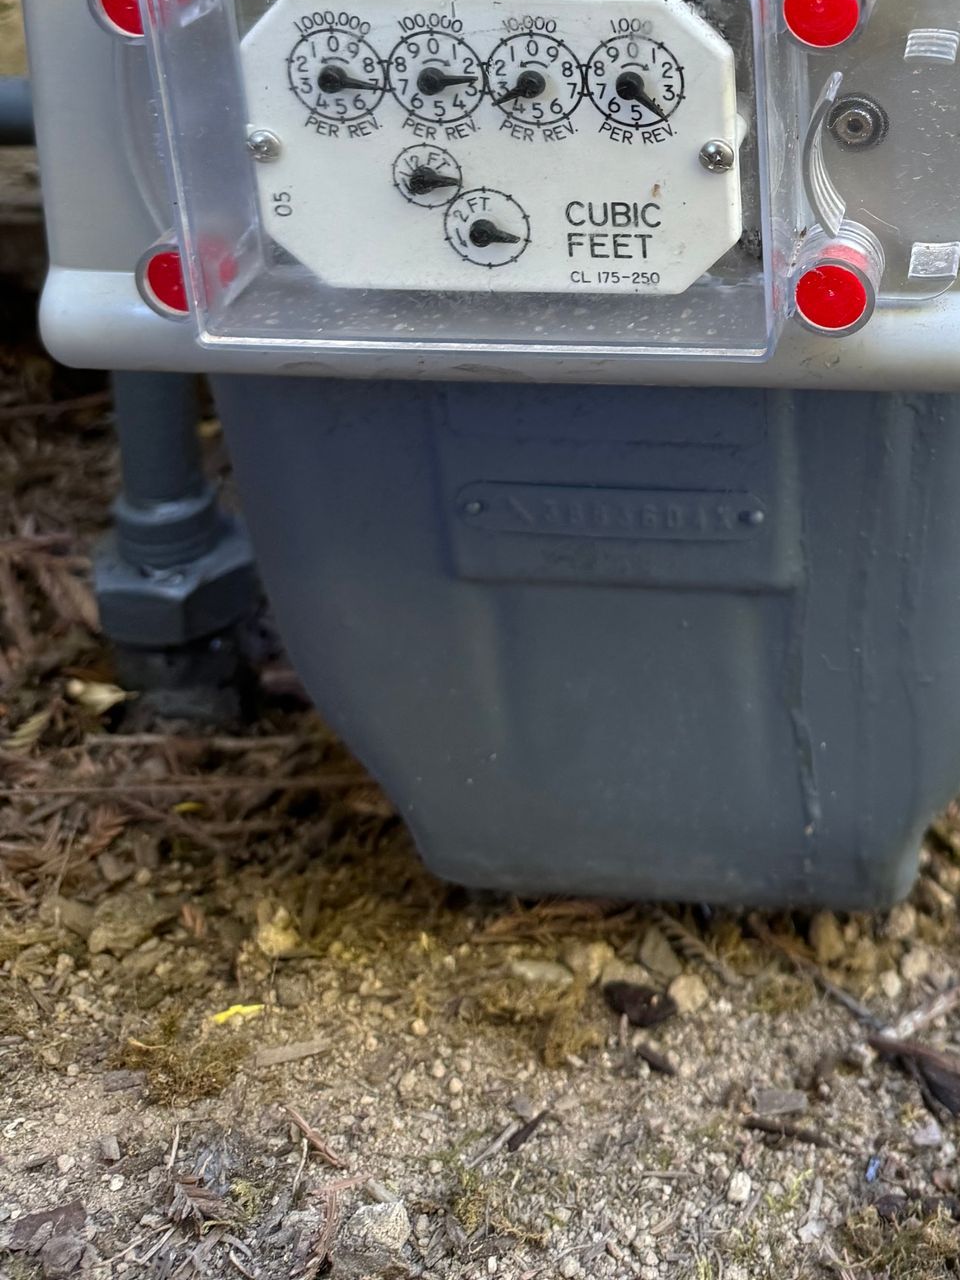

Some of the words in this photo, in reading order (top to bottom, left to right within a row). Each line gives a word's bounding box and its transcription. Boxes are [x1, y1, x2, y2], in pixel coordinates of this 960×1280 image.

[293, 11, 371, 35] 1,000,000
[397, 13, 463, 33] 100,000
[502, 15, 557, 34] 10,000
[610, 17, 653, 34] 1,000
[311, 41, 317, 58] 1
[327, 36, 339, 52] 0
[347, 42, 359, 58] 9
[407, 42, 420, 58] 9
[427, 38, 439, 54] 0
[452, 43, 458, 60] 1
[526, 40, 539, 56] 0
[627, 42, 639, 58] 0
[509, 45, 515, 62] 1
[546, 46, 559, 63] 9
[606, 46, 619, 63] 9
[651, 47, 656, 64] 1
[297, 56, 308, 72] 2
[363, 57, 375, 73] 8
[394, 56, 407, 73] 8
[463, 58, 475, 74] 2
[495, 59, 507, 76] 2
[561, 61, 574, 77] 8
[594, 61, 605, 77] 8
[662, 62, 674, 79] 2
[300, 78, 313, 94] 3
[397, 78, 408, 95] 7
[465, 80, 478, 96] 3
[567, 83, 577, 99] 7
[596, 83, 607, 100] 7
[662, 84, 675, 101] 3
[316, 93, 329, 110] 4
[336, 98, 348, 115] 5
[353, 94, 366, 110] 6
[410, 93, 423, 110] 6
[434, 100, 446, 117] 5
[452, 93, 466, 110] 4
[512, 97, 526, 114] 4
[550, 98, 563, 114] 6
[607, 97, 620, 114] 6
[532, 102, 544, 119] 5
[631, 105, 643, 121] 5
[305, 116, 340, 138] PER
[347, 117, 383, 138] REV.
[402, 117, 437, 140] PER
[445, 119, 481, 140] REV.
[499, 120, 534, 142] PER
[542, 121, 578, 142] REV.
[598, 121, 633, 145] PER
[642, 123, 678, 145] REV.
[453, 209, 470, 223] 2
[565, 200, 661, 228] CUBIC
[567, 233, 653, 258] FEET
[570, 271, 591, 283] CL
[598, 271, 660, 284] 175-250
